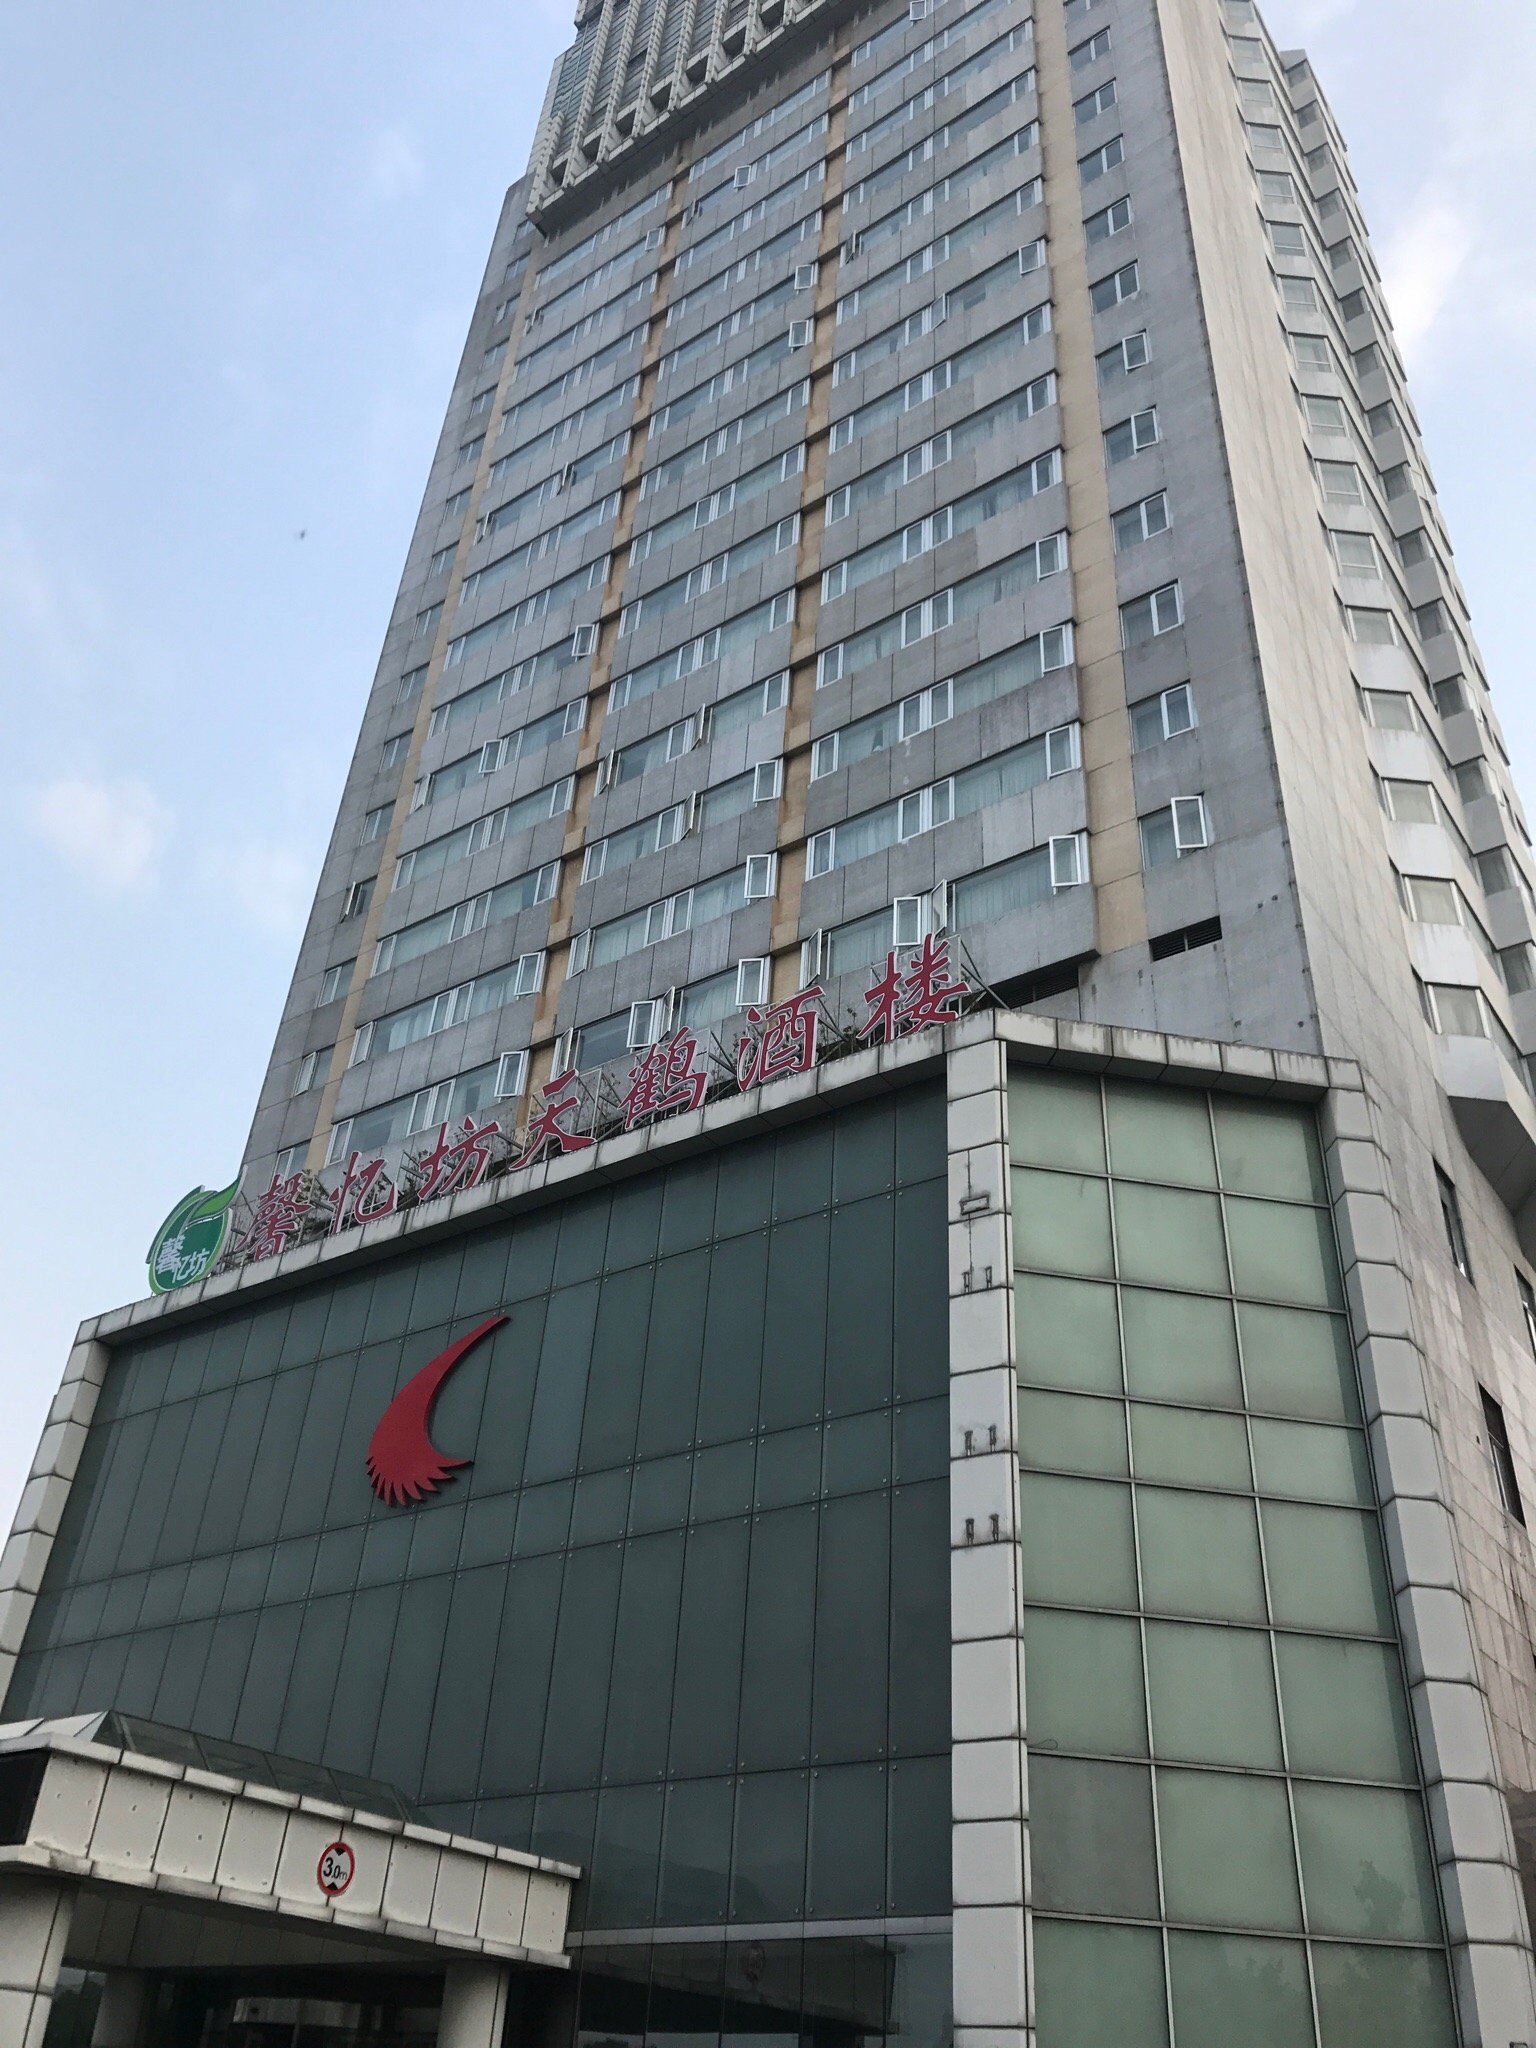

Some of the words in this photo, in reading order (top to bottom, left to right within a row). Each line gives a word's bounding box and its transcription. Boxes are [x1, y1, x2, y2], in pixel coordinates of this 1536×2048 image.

[235, 933, 971, 1262] 馨忆坊天鹤酒楼
